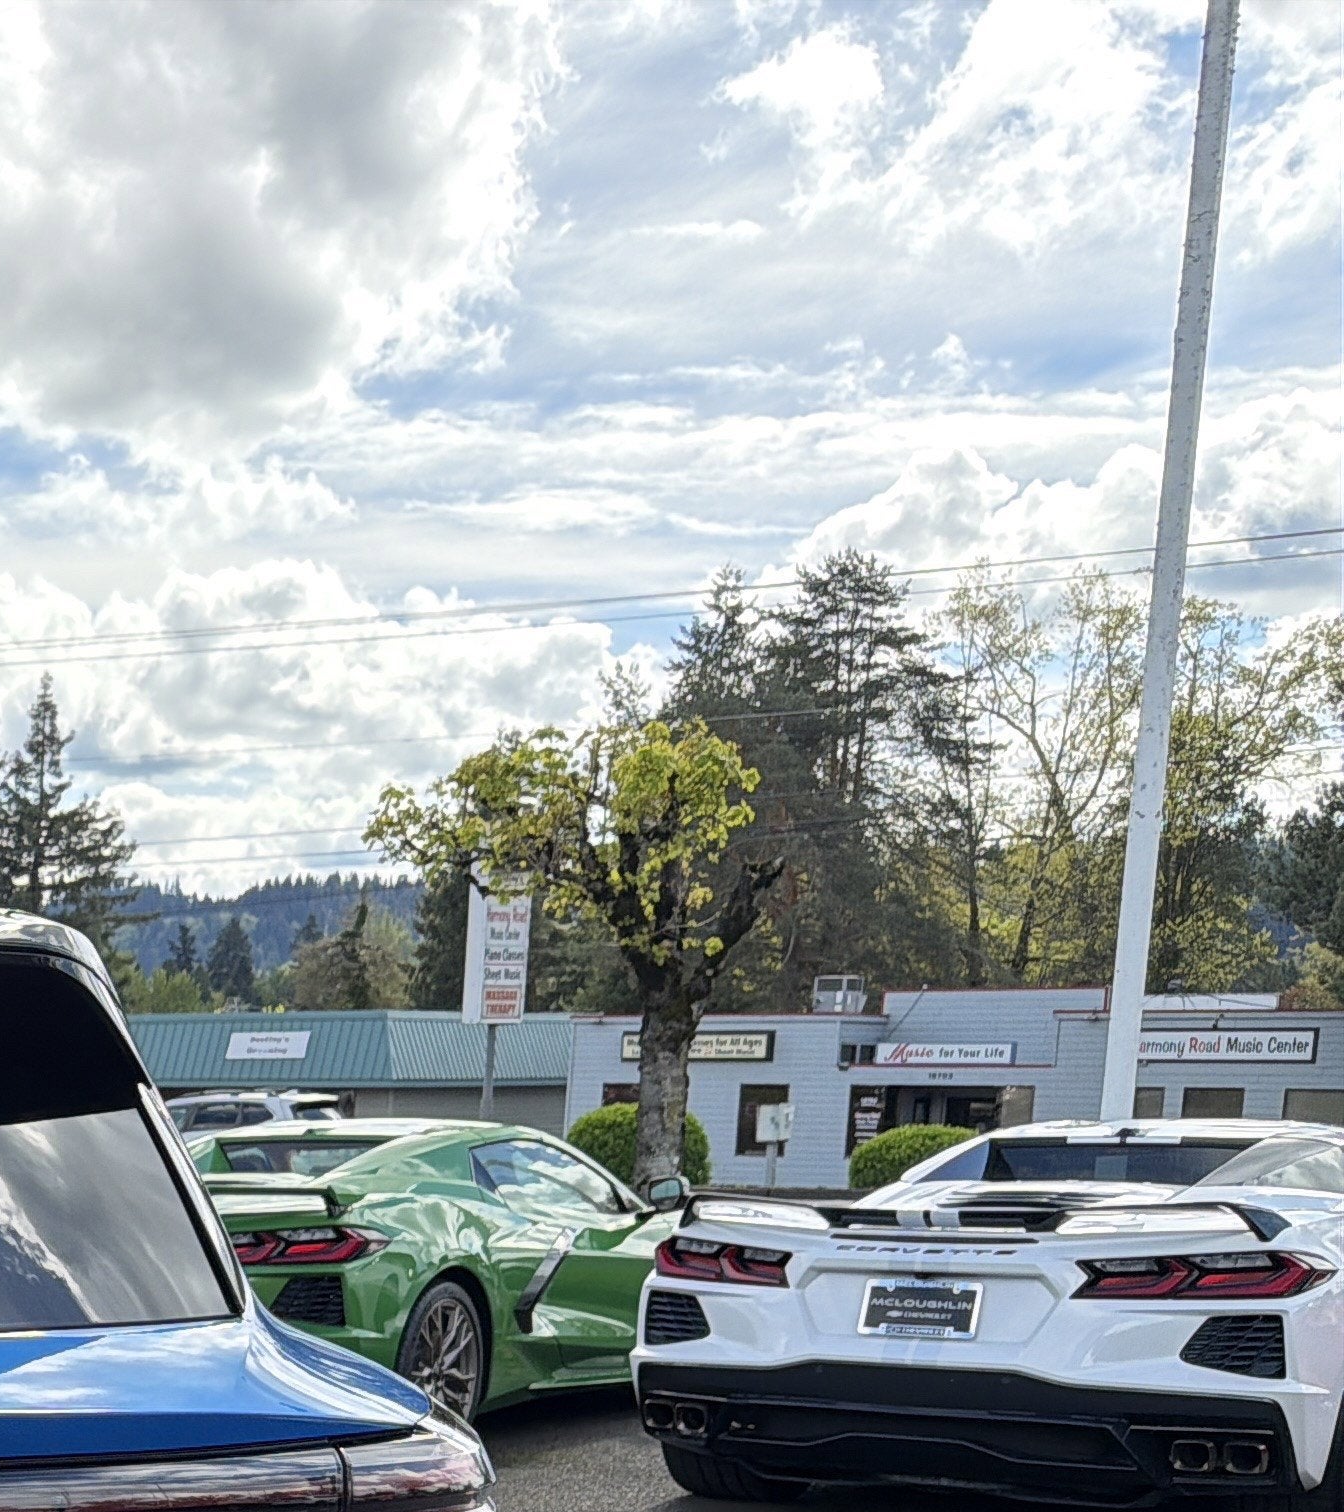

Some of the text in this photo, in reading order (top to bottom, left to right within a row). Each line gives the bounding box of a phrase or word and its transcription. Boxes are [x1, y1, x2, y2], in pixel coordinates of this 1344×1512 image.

[884, 1042, 1005, 1063] Music for Your Life
[1139, 1035, 1310, 1058] armony Road Music Center
[870, 1297, 973, 1311] MCLOUGHLIN
